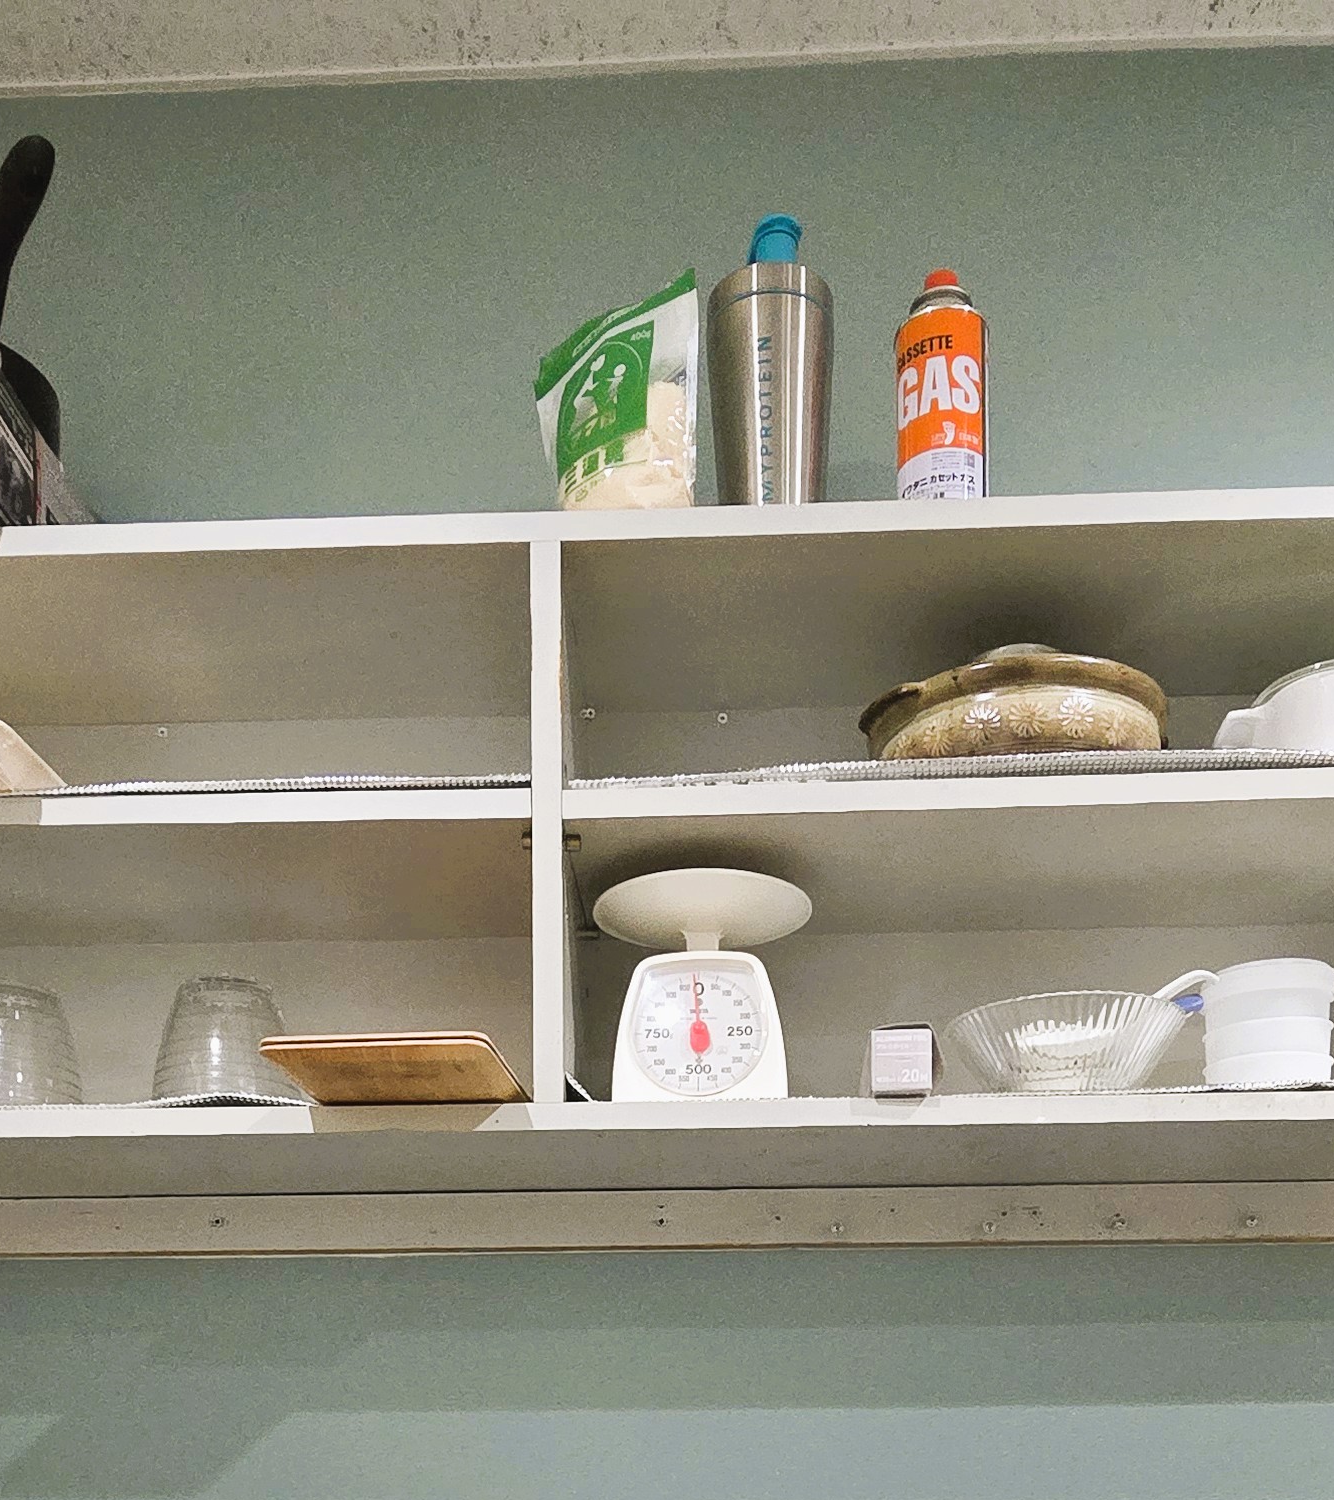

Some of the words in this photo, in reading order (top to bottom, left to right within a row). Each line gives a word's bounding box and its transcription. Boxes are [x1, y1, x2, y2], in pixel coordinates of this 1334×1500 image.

[897, 354, 981, 431] GAS
[757, 335, 774, 502] MYPROTEIN
[727, 1025, 753, 1037] 250
[685, 1064, 712, 1075] 500
